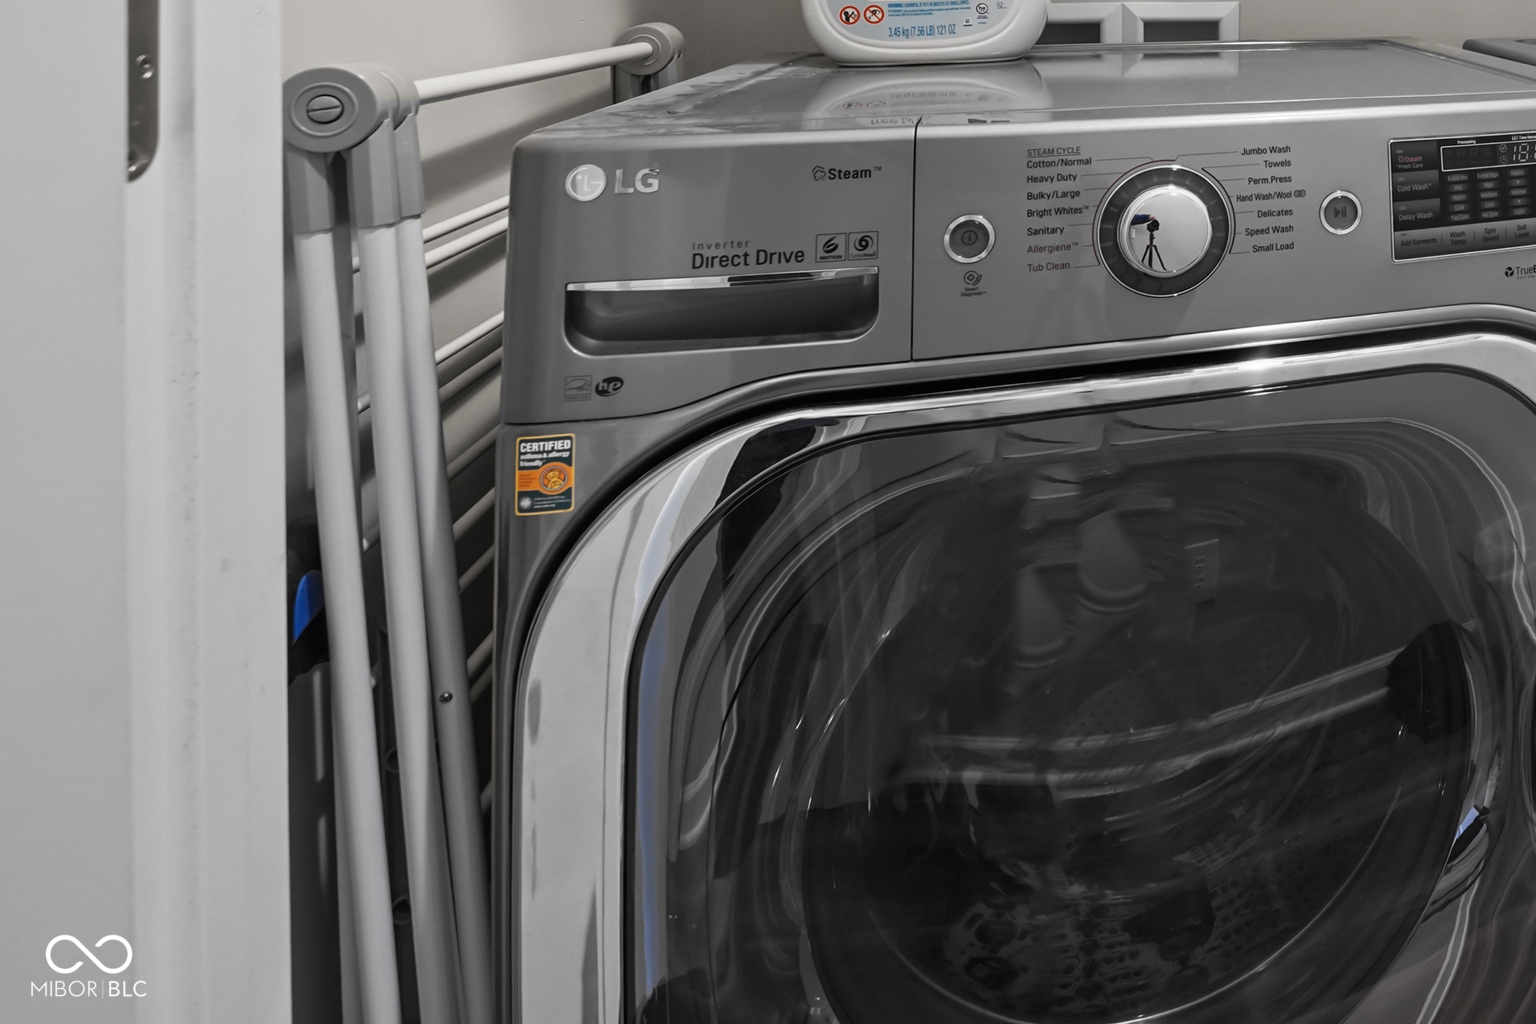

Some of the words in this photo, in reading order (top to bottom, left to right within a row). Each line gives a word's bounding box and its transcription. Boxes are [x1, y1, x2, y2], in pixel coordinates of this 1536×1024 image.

[888, 27, 901, 37] 3.45
[902, 26, 909, 39] kg
[936, 24, 947, 35] 121
[1027, 148, 1055, 156] STEAM
[1056, 146, 1080, 155] CYCLE
[1241, 147, 1267, 156] Jumbo
[1269, 145, 1291, 154] Wash
[1026, 157, 1092, 169] Cotton/Normal
[1263, 159, 1292, 168] Towels
[614, 167, 660, 194] LG
[1027, 175, 1055, 184] Heavy
[1057, 173, 1077, 182] Duty
[1027, 190, 1080, 200] Bulky/Large
[1236, 194, 1253, 202] Hand
[1254, 190, 1292, 200] Wash/Wool
[1027, 208, 1052, 218] Bright
[1257, 209, 1293, 218] Delicates
[1027, 226, 1065, 237] Sanitary
[1245, 227, 1270, 237] Speed
[1272, 224, 1294, 233] Wash
[692, 240, 750, 250] Inverter
[1412, 237, 1437, 245] Garments
[1252, 243, 1274, 253] Small
[1276, 242, 1294, 251] Load
[692, 251, 750, 269] Direct
[756, 249, 805, 266] Drive
[1027, 264, 1044, 272] Tub
[1046, 262, 1070, 270] Clean
[520, 440, 571, 452] CERTIFIED
